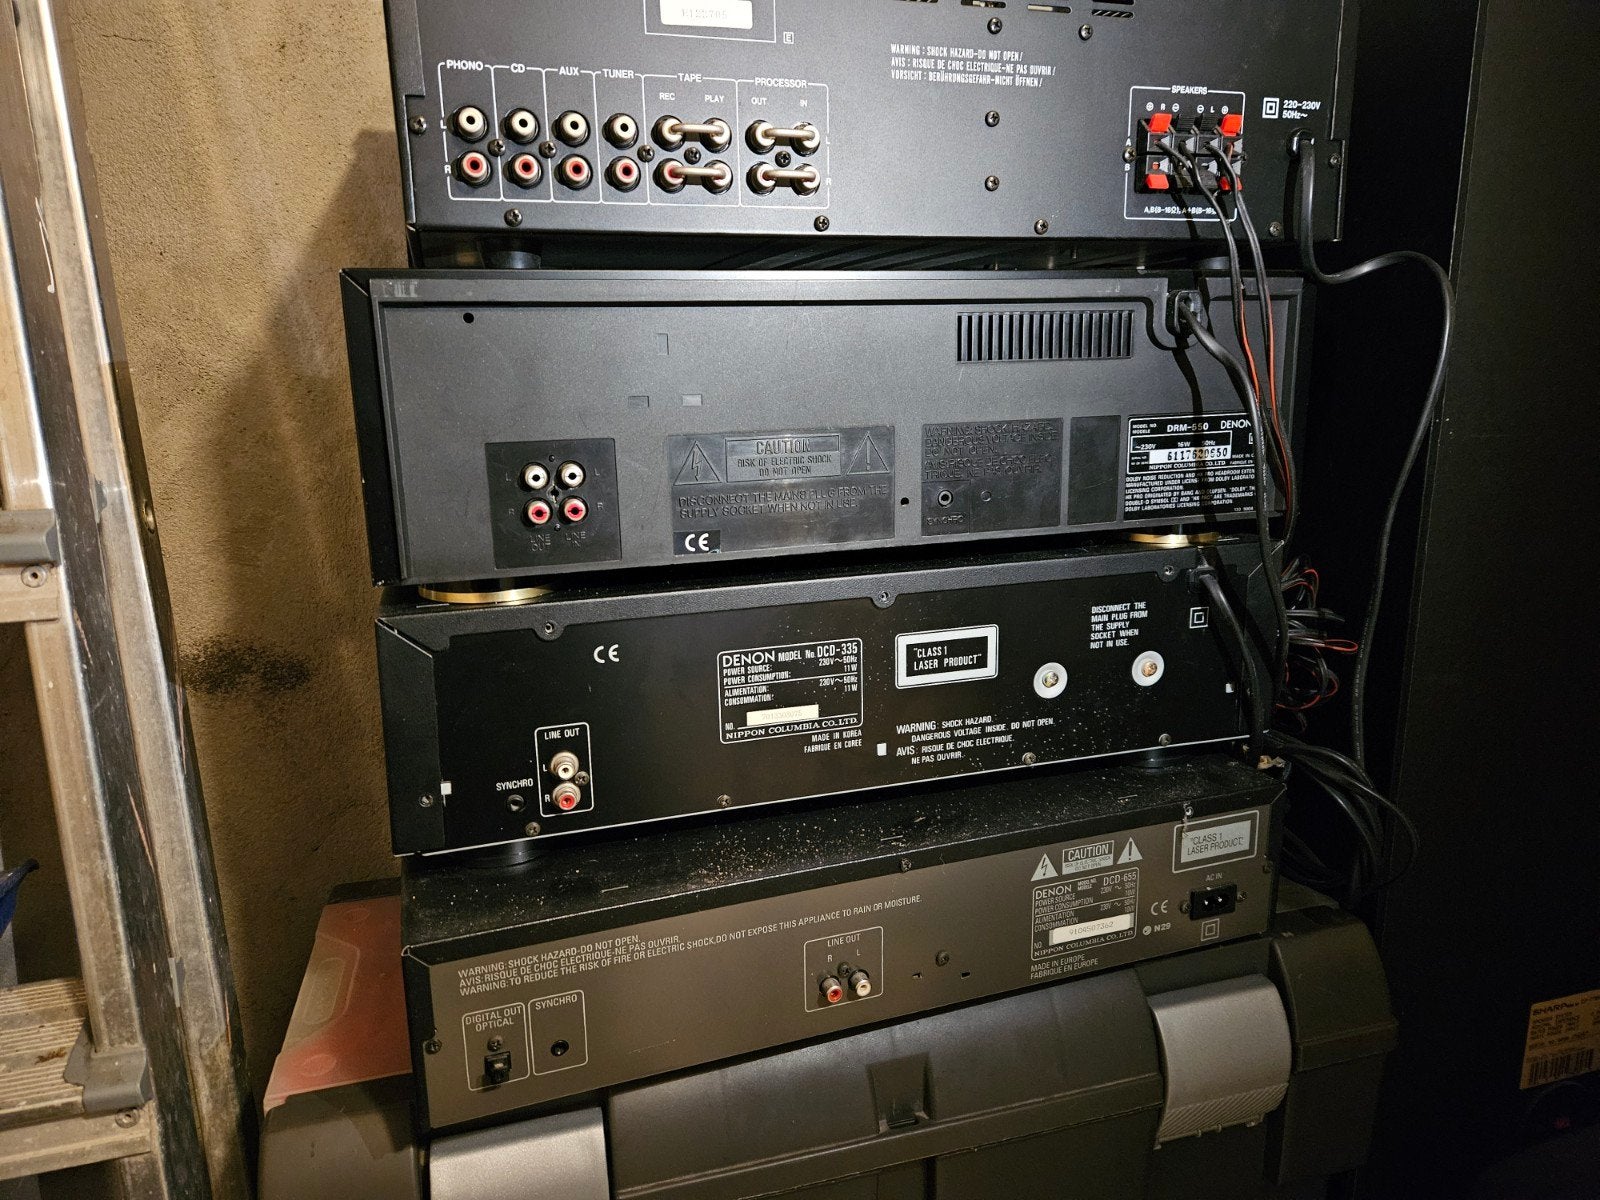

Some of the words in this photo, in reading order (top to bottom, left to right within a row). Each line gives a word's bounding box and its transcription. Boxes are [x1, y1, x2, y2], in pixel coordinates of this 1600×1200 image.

[927, 46, 948, 57] SHOCK
[988, 50, 1001, 60] NOT
[447, 60, 483, 70] PHONO
[511, 63, 525, 73] CD
[559, 66, 579, 76] AUX
[602, 69, 634, 79] TUNER
[678, 73, 702, 83] TAPE
[754, 77, 808, 89] PROCESSOR
[1172, 85, 1208, 95] SPEAKERS
[659, 92, 675, 101] REC
[704, 95, 725, 103] PLAY
[752, 97, 767, 106] OUT
[1283, 100, 1321, 110] 220-230V
[440, 119, 447, 129] L
[1125, 138, 1132, 146] A
[444, 165, 451, 174] R
[756, 438, 810, 455] CAUTION
[684, 533, 709, 551] CE
[1092, 603, 1131, 614] DISCONNECT
[1091, 615, 1108, 623] MAIN
[1130, 610, 1148, 618] FROM
[1106, 622, 1130, 630] SUPPLY
[1091, 631, 1116, 640] SOCKET
[1120, 629, 1139, 637] WHEN
[1090, 641, 1103, 649] NOT
[594, 644, 620, 664] CE
[723, 651, 775, 667] DENON
[778, 650, 802, 662] MODEL
[817, 642, 858, 658] DCD-335
[723, 667, 745, 677] POWER
[748, 664, 772, 674] SOURCE:
[914, 659, 938, 671] LASER
[724, 676, 745, 686] POWER
[748, 671, 791, 683] CONSUMPTION:
[725, 686, 769, 697] ALIMENTATION:
[725, 694, 774, 706] CONSOMMATION:
[942, 720, 963, 729] SHOCK
[545, 730, 561, 740] LINE
[564, 728, 580, 738] OUT
[726, 728, 765, 740] NIPPON
[768, 722, 820, 734] COLUMBIA
[812, 734, 830, 742] MADE
[843, 729, 862, 738] KOREA
[912, 729, 951, 742] DANGEROUS
[954, 727, 982, 737] VOLTAGE
[1011, 722, 1020, 730] DO
[1023, 720, 1035, 728] NOT
[804, 742, 830, 753] FABRIQUE
[834, 741, 842, 749] EN
[844, 739, 862, 748] COREE
[922, 744, 944, 753] RISQUE
[946, 742, 955, 750] DE
[957, 740, 974, 749] CHOC
[912, 756, 920, 765] NE
[922, 754, 935, 763] PAS
[543, 764, 547, 772] L
[496, 778, 534, 791] SYNCHRO
[545, 794, 550, 802] R
[1068, 844, 1109, 861] CAUTION
[1188, 843, 1209, 855] LASER
[1036, 885, 1072, 899] DENON
[1104, 872, 1136, 886] DCD-655
[1151, 900, 1168, 915] CE
[509, 976, 521, 986] TO
[524, 969, 558, 984] REDUCE
[561, 965, 578, 975] THE
[579, 960, 599, 972] RISK
[601, 957, 612, 967] OF
[614, 953, 632, 965] FIRE
[634, 950, 646, 960] OR
[648, 942, 685, 958] ELECTRIC
[729, 930, 745, 940] NOT
[748, 923, 778, 937] EXPOSE
[779, 920, 797, 930] THIS
[799, 911, 841, 927] APPLIANCE
[842, 908, 852, 917] TO
[853, 904, 872, 916] RAIN
[873, 902, 883, 912] OR
[828, 937, 844, 948] LINE
[846, 934, 860, 944] OUT
[458, 962, 506, 979] WARNING:
[508, 955, 539, 968] SHOCK
[595, 941, 613, 952] NOT
[615, 935, 640, 947] OPEN.
[485, 970, 518, 983] RISQUE
[521, 966, 531, 975] DE
[534, 960, 558, 973] CHOC
[629, 941, 646, 953] PAS
[1031, 962, 1050, 972] MADE
[1061, 954, 1085, 965] EUROPE
[1031, 966, 1063, 980] FABRIQUE
[1064, 964, 1072, 972] EN
[1074, 958, 1098, 970] EUROPE
[535, 994, 578, 1010] SYNCHRO
[465, 1011, 502, 1025] DIGITAL
[504, 1006, 522, 1016] OUT
[476, 1017, 514, 1032] OPTICAL
